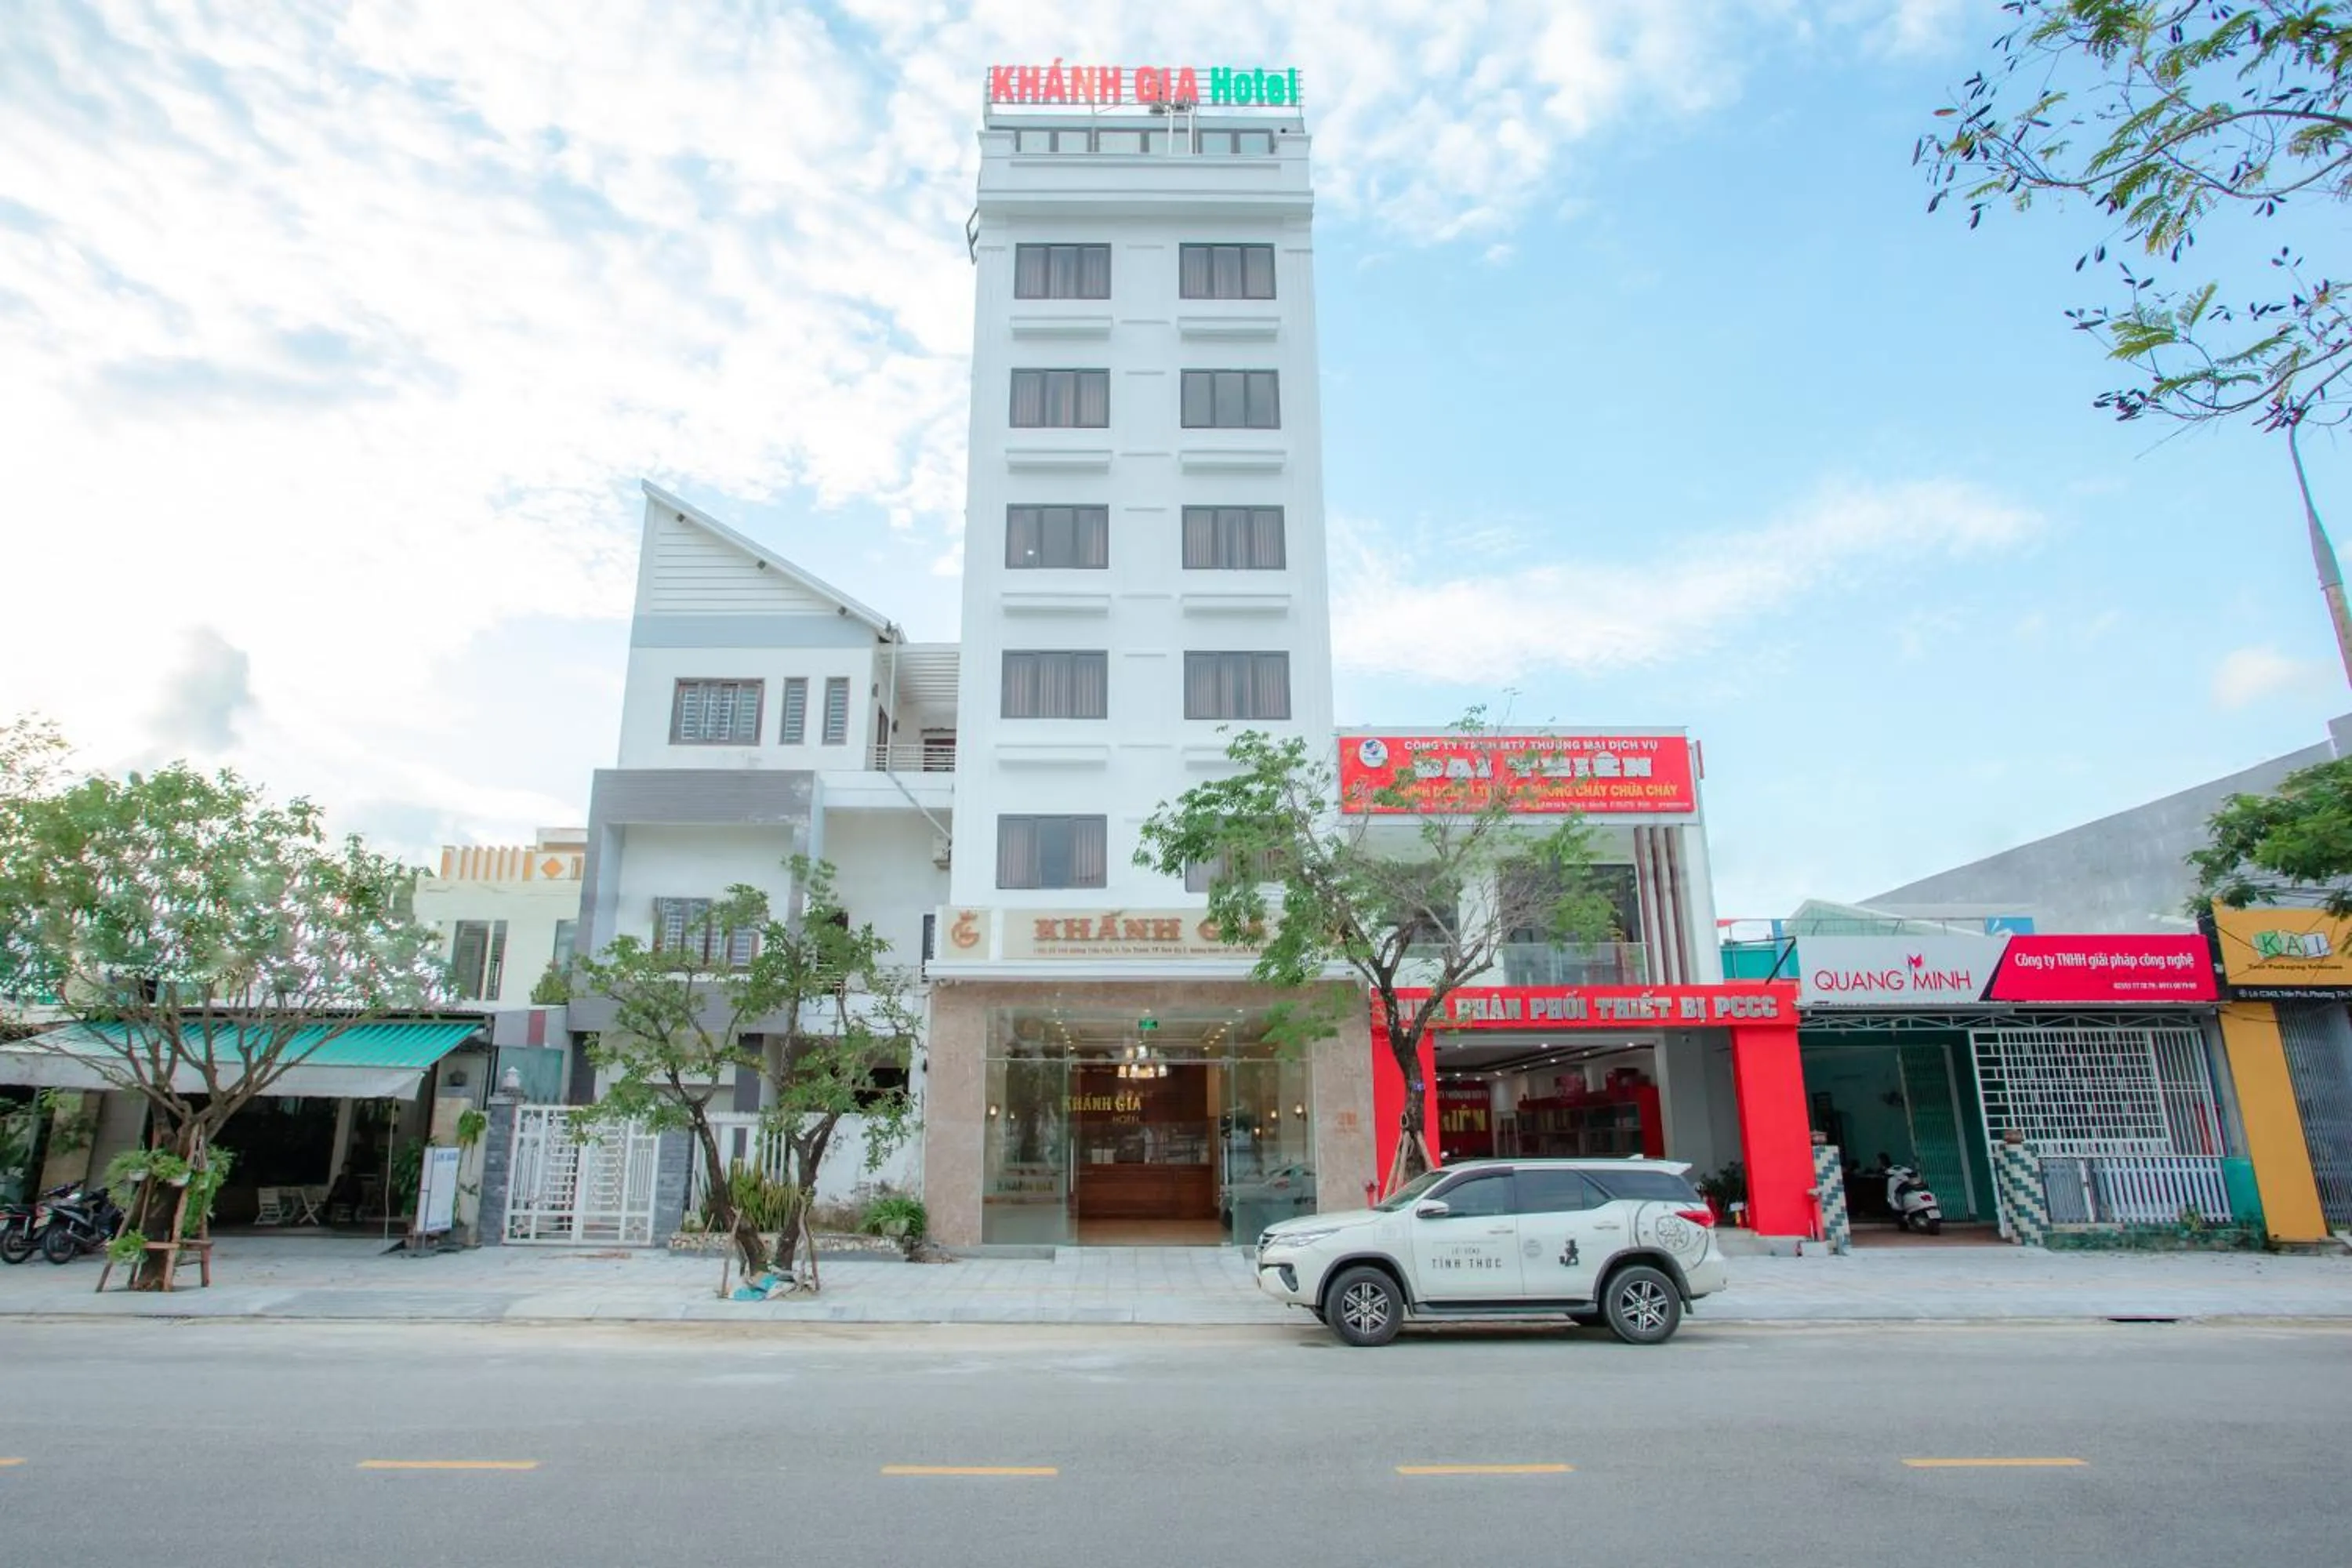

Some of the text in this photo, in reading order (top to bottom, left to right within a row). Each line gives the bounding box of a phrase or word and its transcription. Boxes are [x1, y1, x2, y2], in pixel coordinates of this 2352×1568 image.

[991, 57, 1298, 105] KHÁNH GIA Hotel
[1033, 910, 1181, 941] KHÁNH
[2014, 952, 2194, 970] Công ty TNHH giải pháp công nghệ
[1814, 970, 1972, 992] QUANG MINH
[1454, 993, 1522, 1020] PHÂN
[1530, 990, 1588, 1019] PHỐI
[1595, 991, 1672, 1019] THIẾT
[1679, 996, 1706, 1022] BỊ
[1714, 996, 1778, 1018] PCCC
